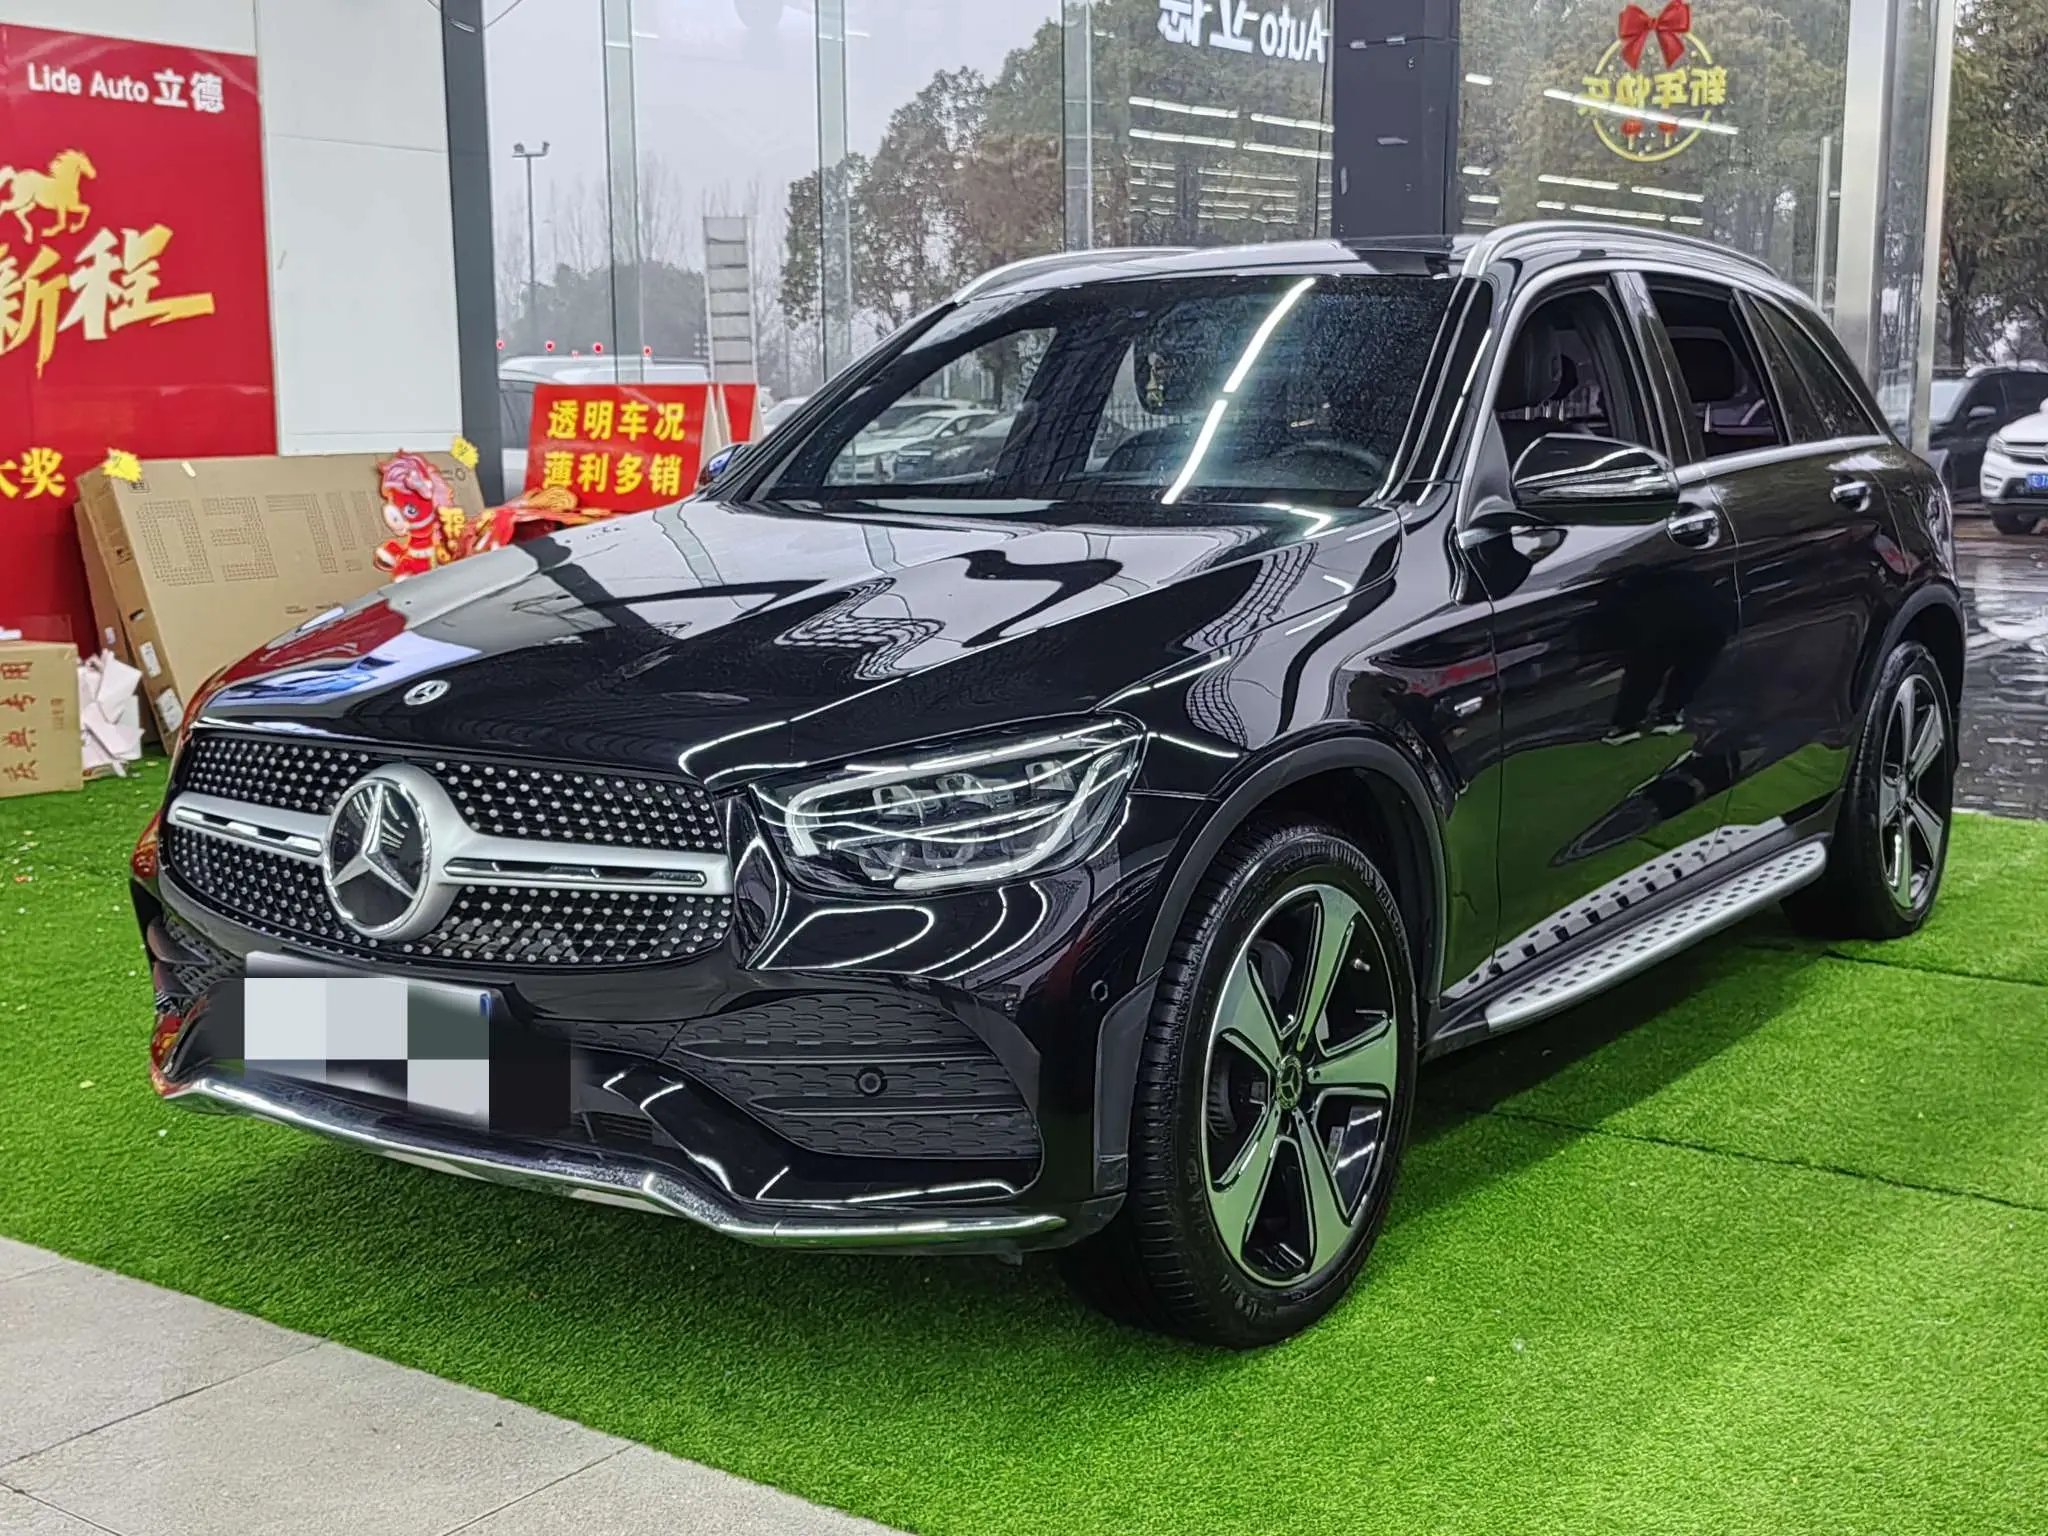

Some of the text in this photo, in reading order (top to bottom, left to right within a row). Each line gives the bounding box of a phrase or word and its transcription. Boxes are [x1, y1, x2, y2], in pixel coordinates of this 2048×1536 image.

[28, 62, 225, 114] Lide Auto 立德
[547, 399, 686, 442] 透明车况
[542, 450, 683, 497] 薄利多销
